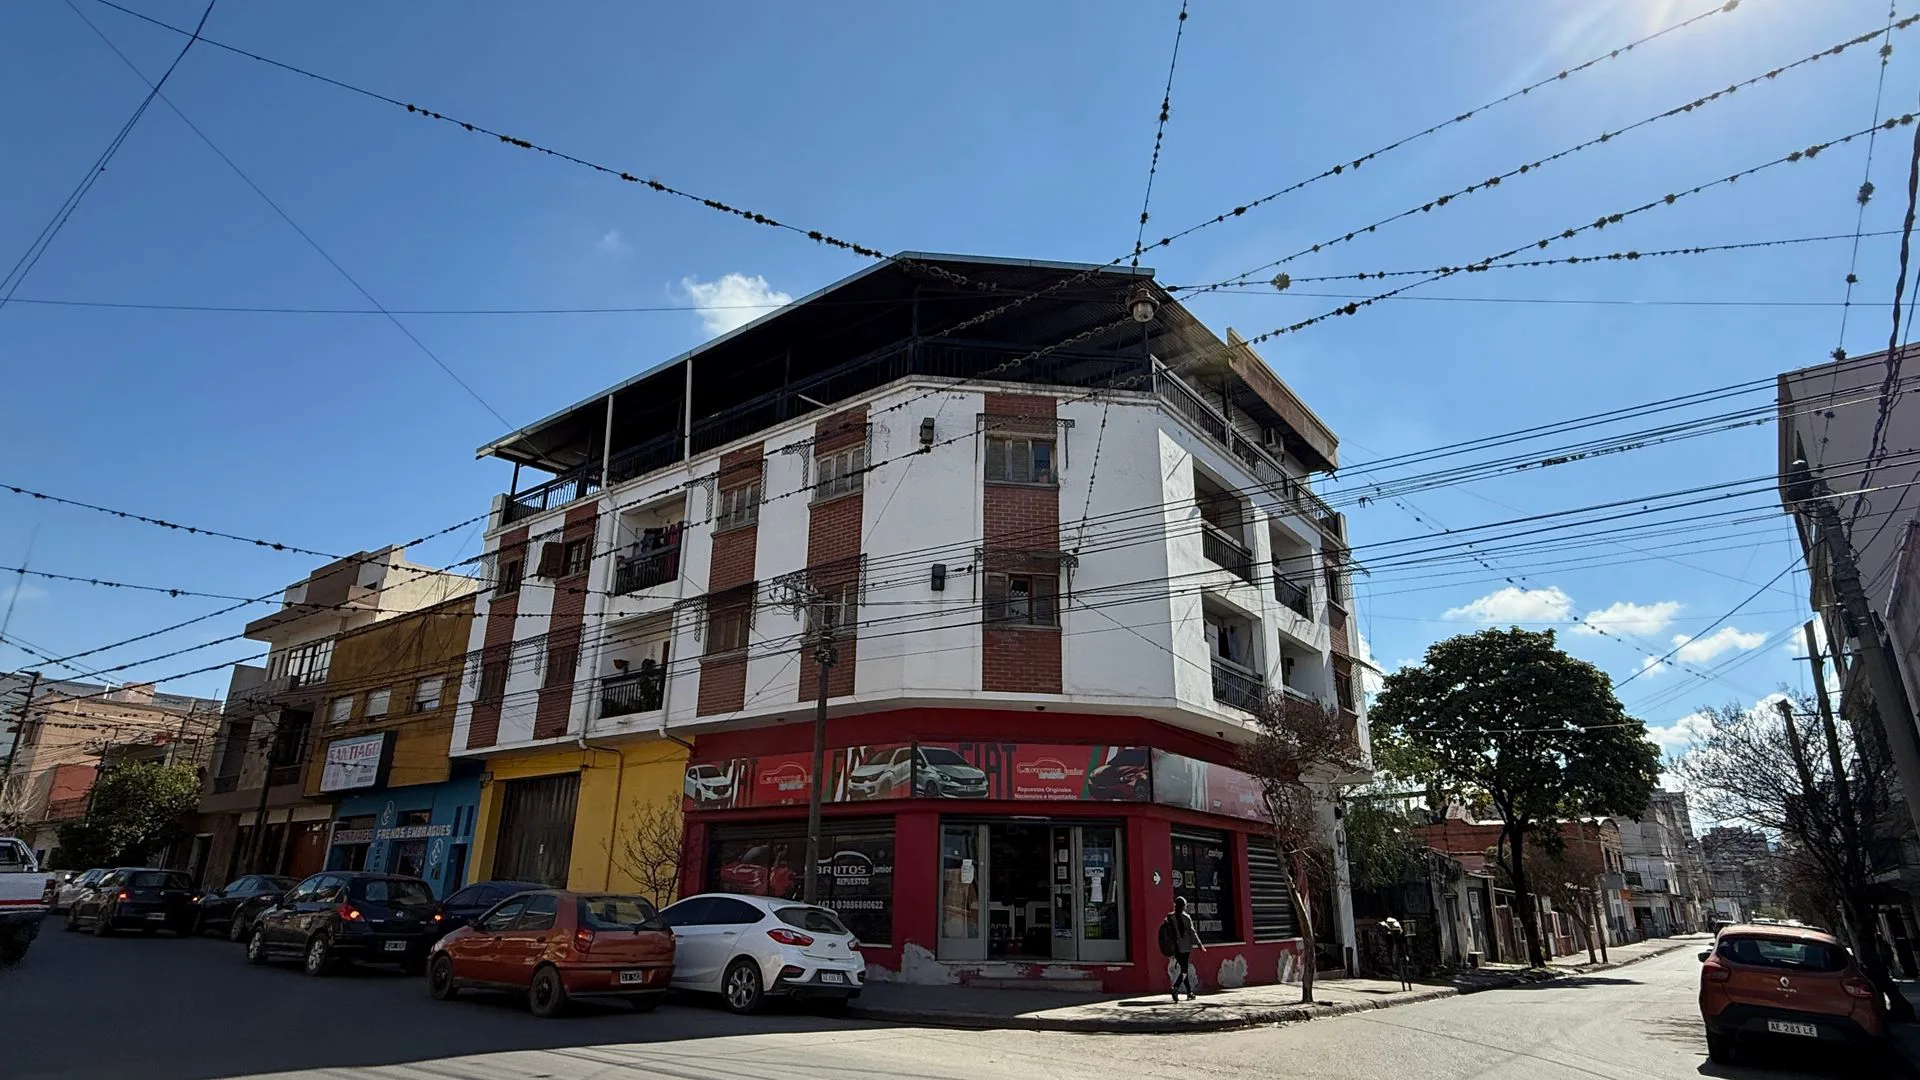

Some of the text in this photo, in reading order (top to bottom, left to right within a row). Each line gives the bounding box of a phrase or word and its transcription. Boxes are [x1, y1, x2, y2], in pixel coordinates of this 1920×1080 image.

[328, 743, 380, 761] SANTIAGO
[872, 865, 892, 875] junior
[836, 877, 870, 886] REPUESTOS
